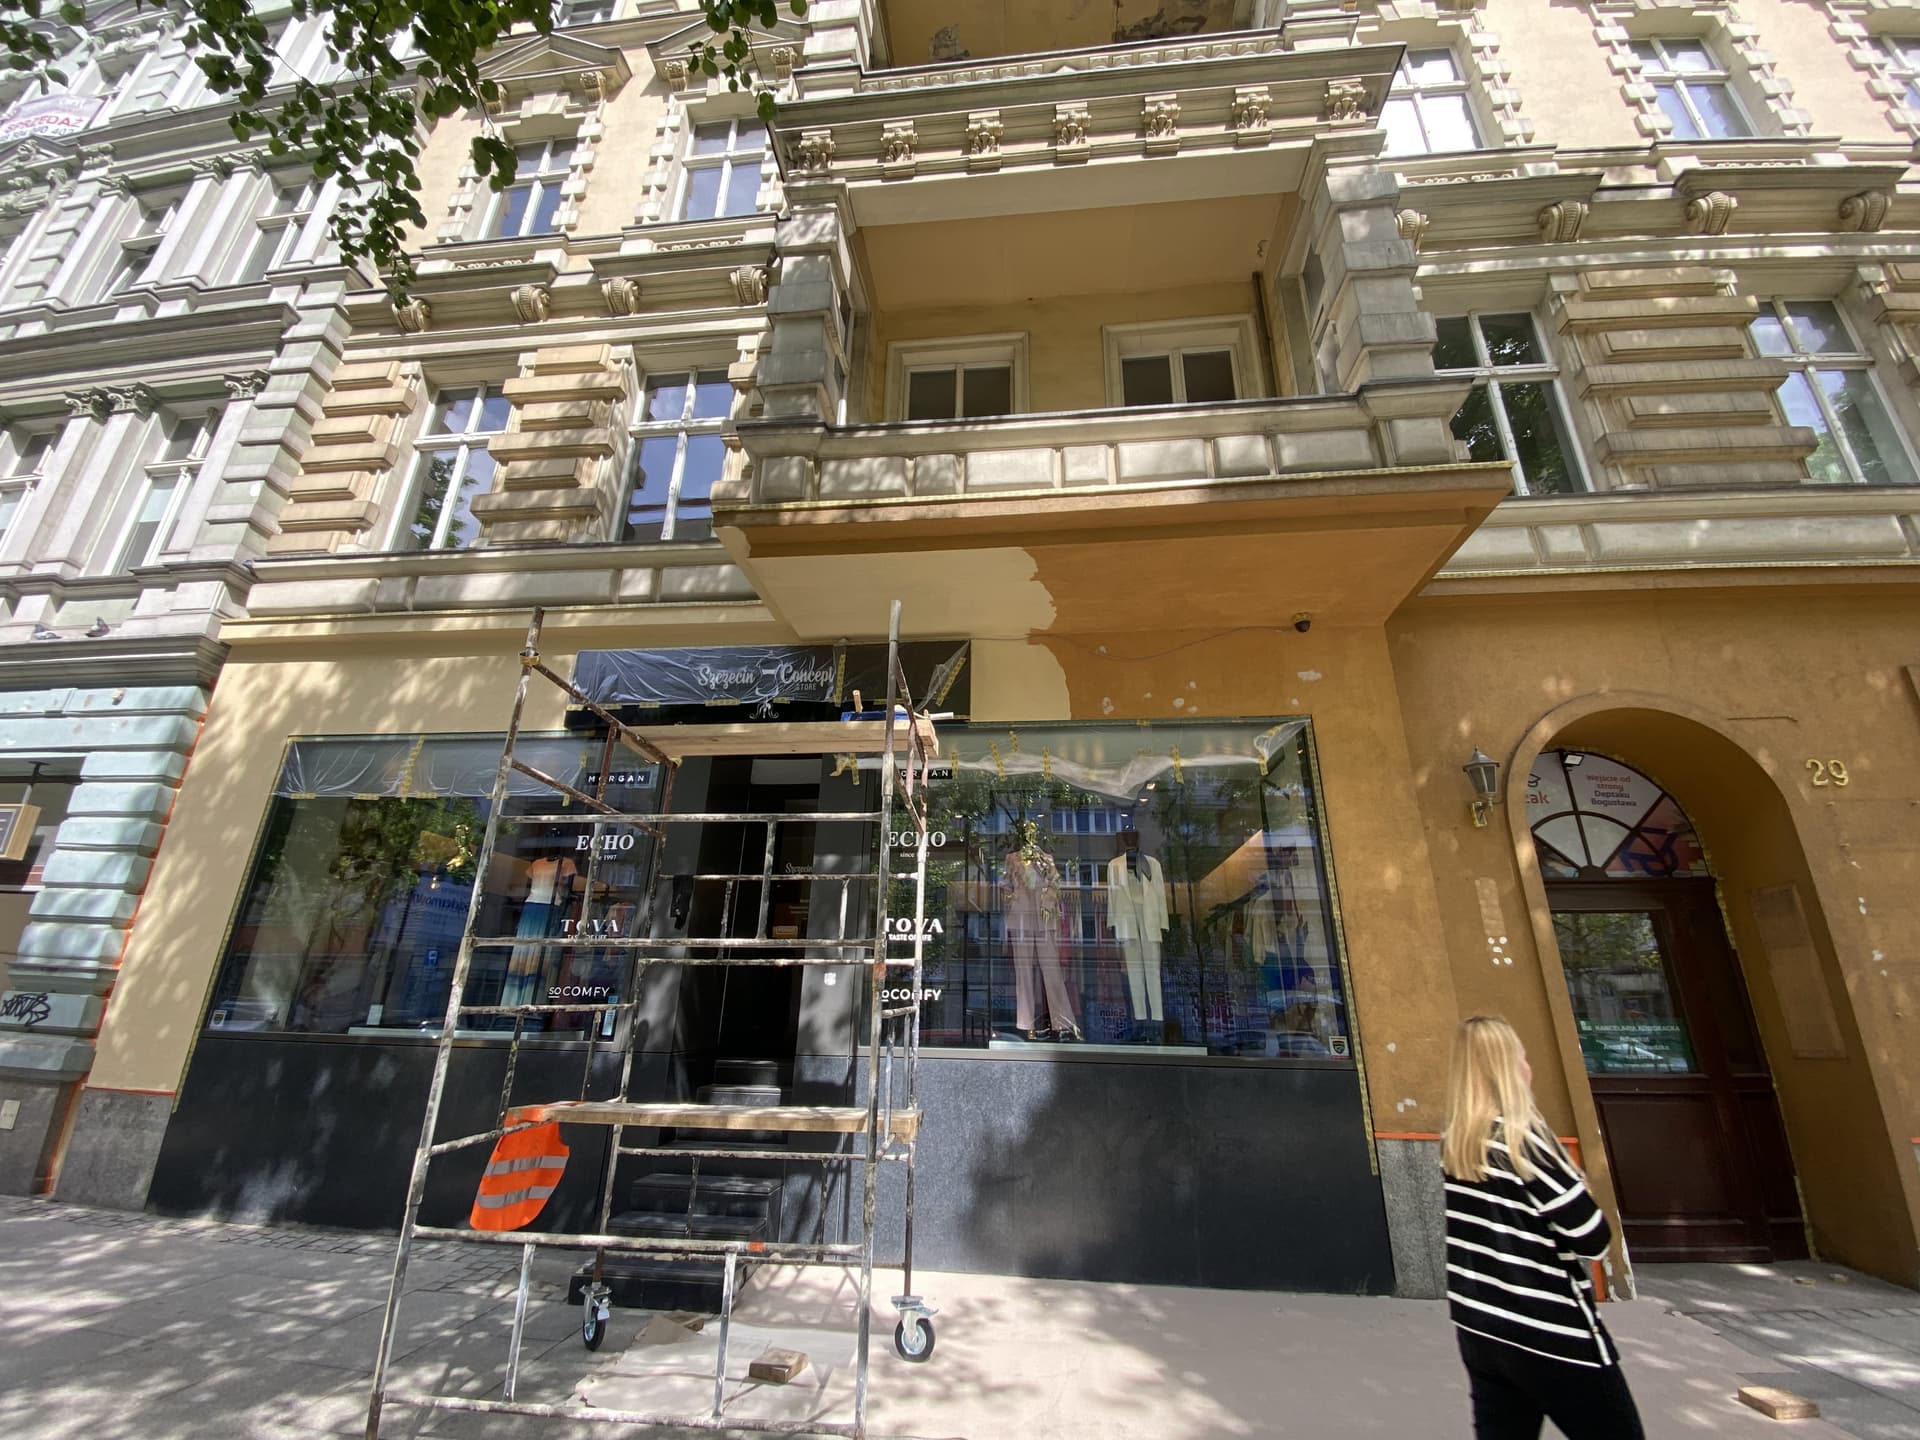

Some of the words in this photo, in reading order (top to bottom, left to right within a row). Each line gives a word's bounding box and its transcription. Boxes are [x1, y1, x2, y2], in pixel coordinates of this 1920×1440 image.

[697, 665, 755, 690] Szczecin
[780, 662, 835, 687] Concept
[588, 774, 645, 783] MRGAN
[899, 768, 949, 777] ORAN
[1806, 759, 1848, 785] 29
[1526, 791, 1550, 804] ak
